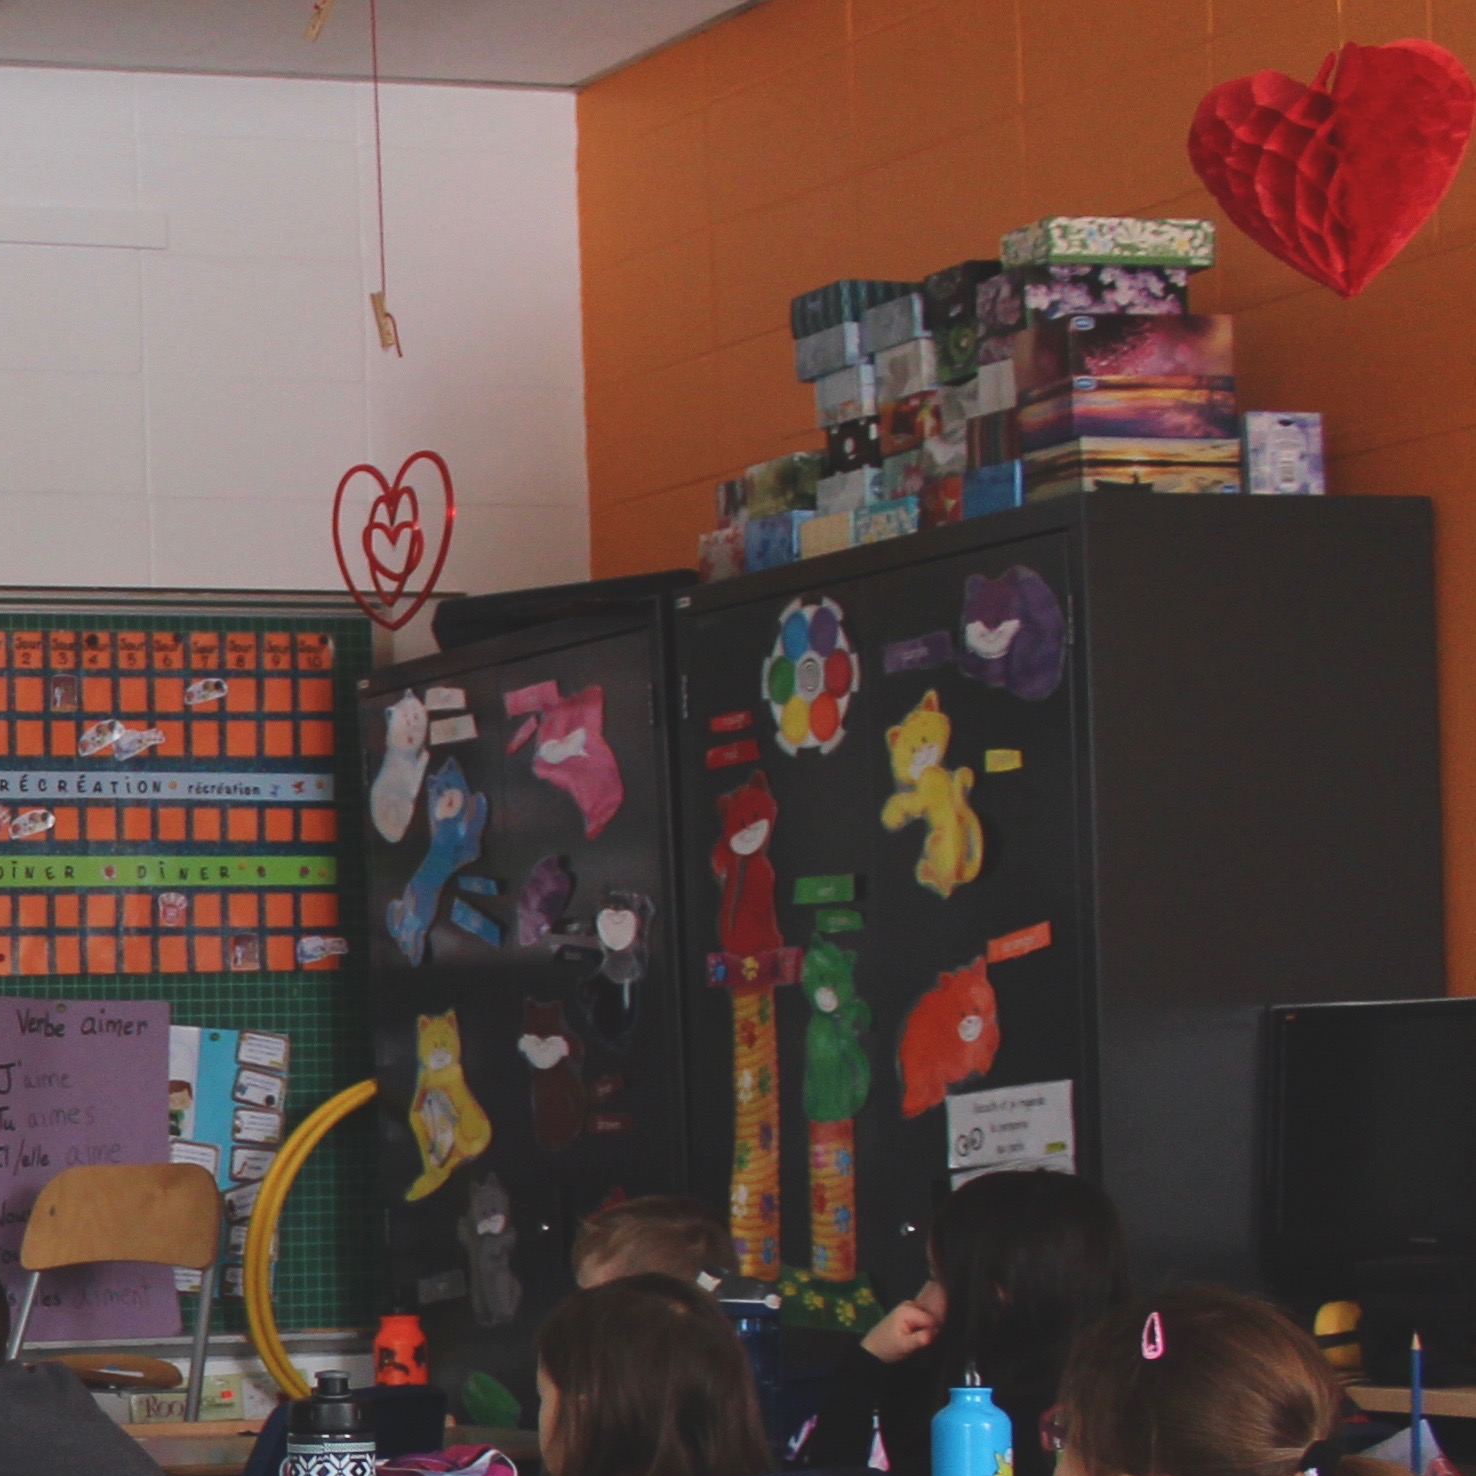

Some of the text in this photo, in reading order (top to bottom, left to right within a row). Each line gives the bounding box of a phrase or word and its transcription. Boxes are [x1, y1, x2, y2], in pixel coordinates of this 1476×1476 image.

[16, 637, 41, 649] Jour
[21, 652, 32, 665] 2
[58, 652, 69, 665] 3
[88, 654, 97, 664] 4
[236, 654, 245, 667] 8
[272, 654, 281, 667] 9
[307, 655, 323, 667] 10
[188, 782, 261, 796] récréation
[17, 1009, 147, 1037] Verbe aimer
[67, 1142, 122, 1165] aime
